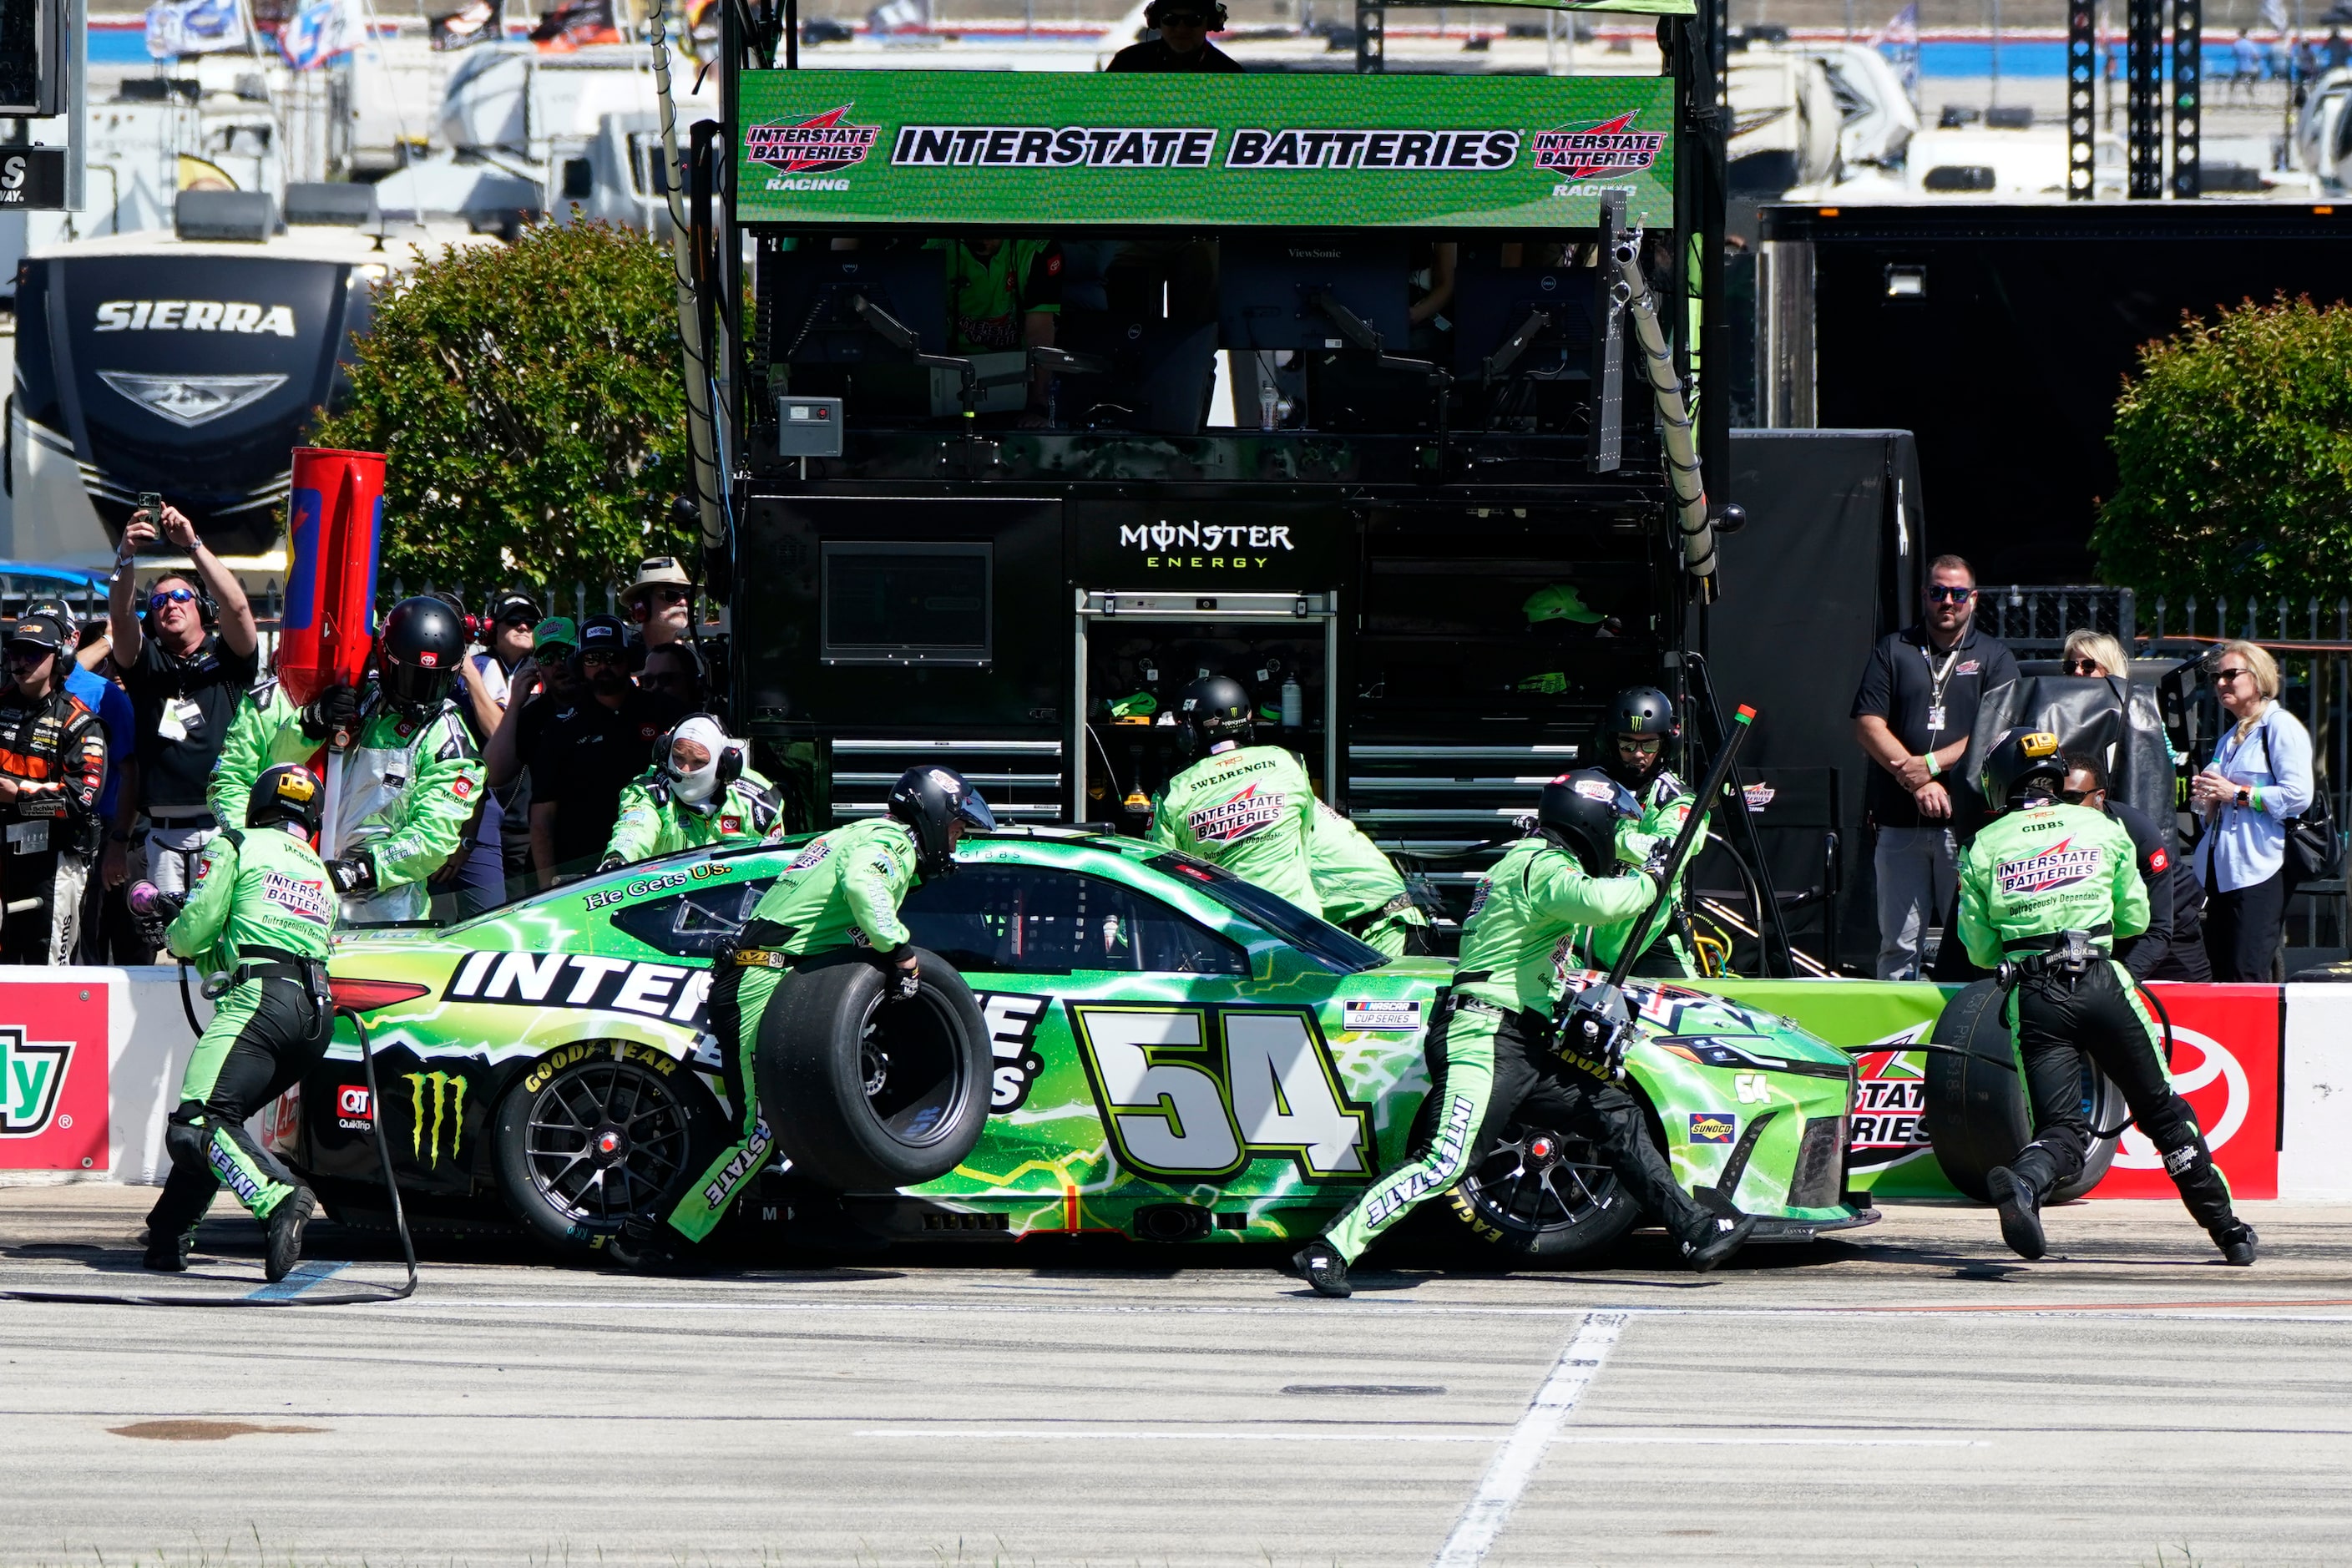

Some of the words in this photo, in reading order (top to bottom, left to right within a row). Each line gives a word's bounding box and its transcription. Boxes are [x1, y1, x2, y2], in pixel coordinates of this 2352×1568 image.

[750, 128, 874, 144] INTERSTATE
[893, 127, 1216, 166] INTERSTATE
[1228, 129, 1519, 168] BATTERIES
[1535, 133, 1662, 150] INTERSTATE
[752, 144, 865, 160] BATTERIES
[1539, 151, 1653, 167] BATTERIES
[765, 178, 850, 191] RACING
[1552, 185, 1637, 196] RACIG
[1288, 248, 1342, 260] ViewSonic
[94, 301, 296, 336] SIERRA
[1120, 520, 1294, 552] MONSTER
[1147, 557, 1267, 568] ENERGY
[1183, 698, 1198, 711] 54
[1190, 761, 1277, 792] SWEARENGIN
[1190, 795, 1283, 827] INTERSTATE
[1197, 808, 1280, 841] BATTERIES
[2021, 821, 2065, 833] GIBBS
[283, 843, 322, 871] JACKSON
[959, 851, 1020, 859] GIBBS
[1999, 850, 2099, 878] INTERSTATE
[584, 889, 623, 912] He
[627, 873, 687, 898] Gets
[690, 862, 733, 880] Us.
[2005, 864, 2094, 891] BATTERIES
[2009, 896, 2057, 917] Outrageously
[2059, 892, 2100, 903] Dependable
[262, 914, 308, 935] Outrageously
[1354, 1014, 1377, 1023] CUP
[1378, 1014, 1409, 1024] SERIES
[1368, 1002, 1410, 1011] NASCAR
[524, 1039, 676, 1094] GOODYEAR
[341, 1089, 370, 1115] QT
[1077, 1008, 1370, 1176] 54
[1734, 1074, 1773, 1105] 54
[338, 1118, 372, 1131] QuikTrip
[1692, 1124, 1732, 1134] SUNOCO
[1851, 1117, 1931, 1142] RIES
[210, 1141, 258, 1202] INTER
[1366, 1095, 1474, 1227] INTERSTATE
